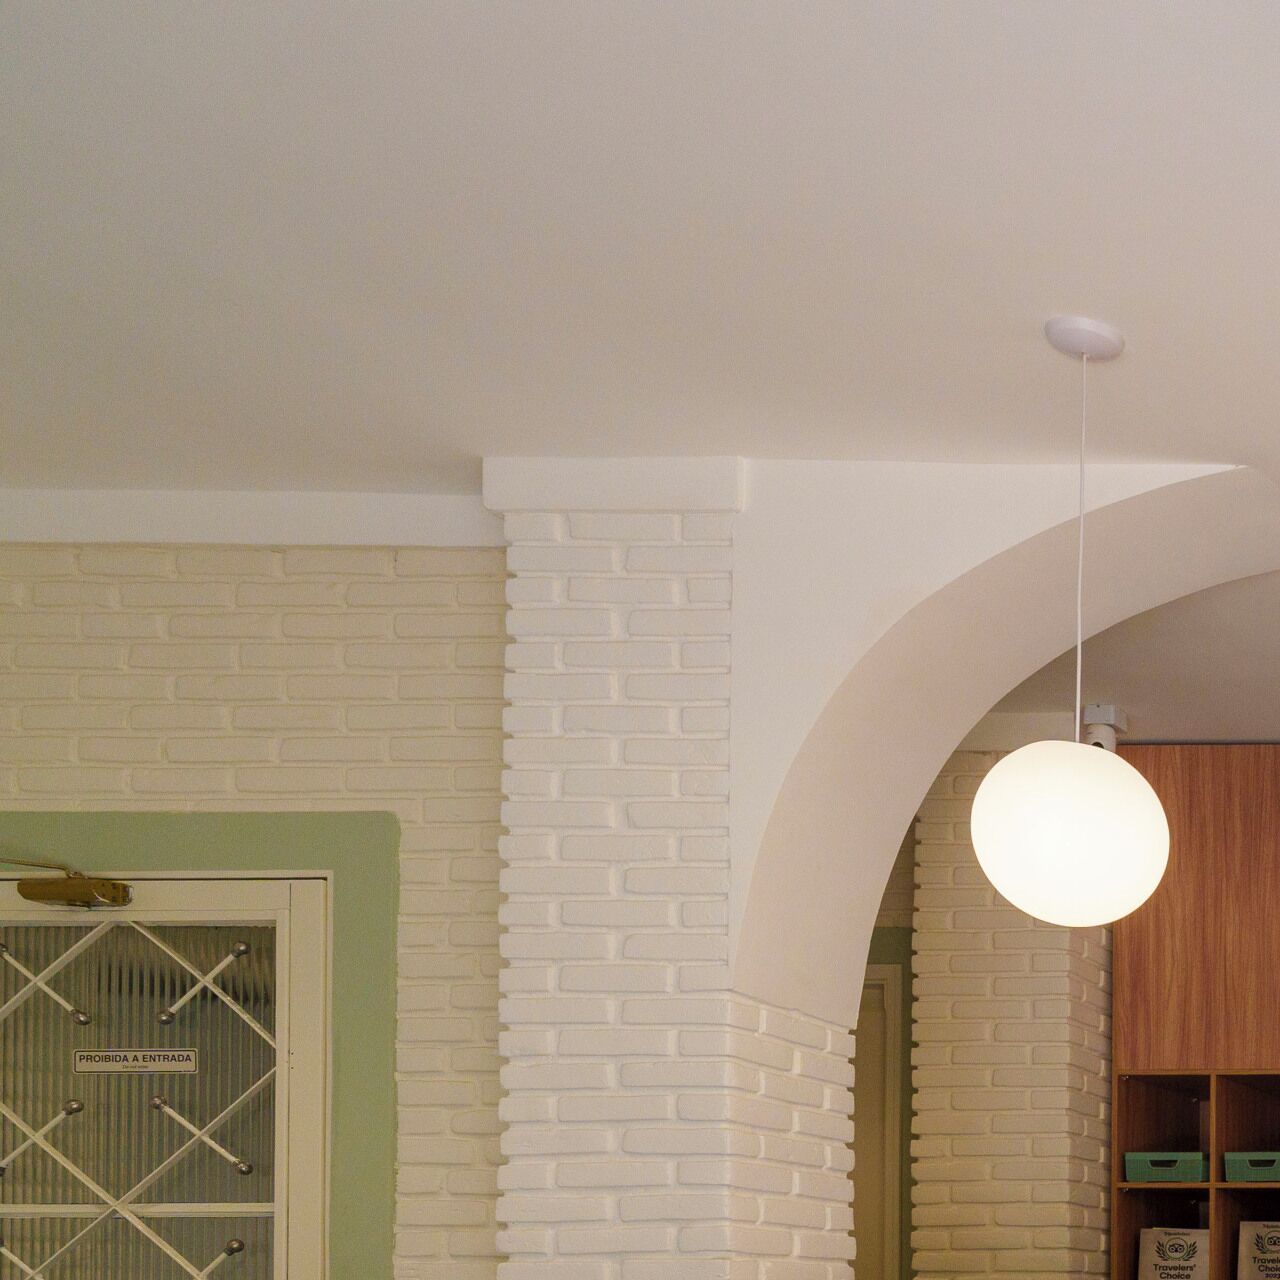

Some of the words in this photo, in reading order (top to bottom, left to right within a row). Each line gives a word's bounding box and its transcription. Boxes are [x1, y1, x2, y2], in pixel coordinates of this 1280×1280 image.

[79, 1054, 129, 1063] PROIBIDA
[132, 1054, 139, 1063] A
[142, 1054, 192, 1063] ENTRADA
[1152, 1263, 1197, 1271] Travelers'
[1159, 1271, 1191, 1279] Choice
